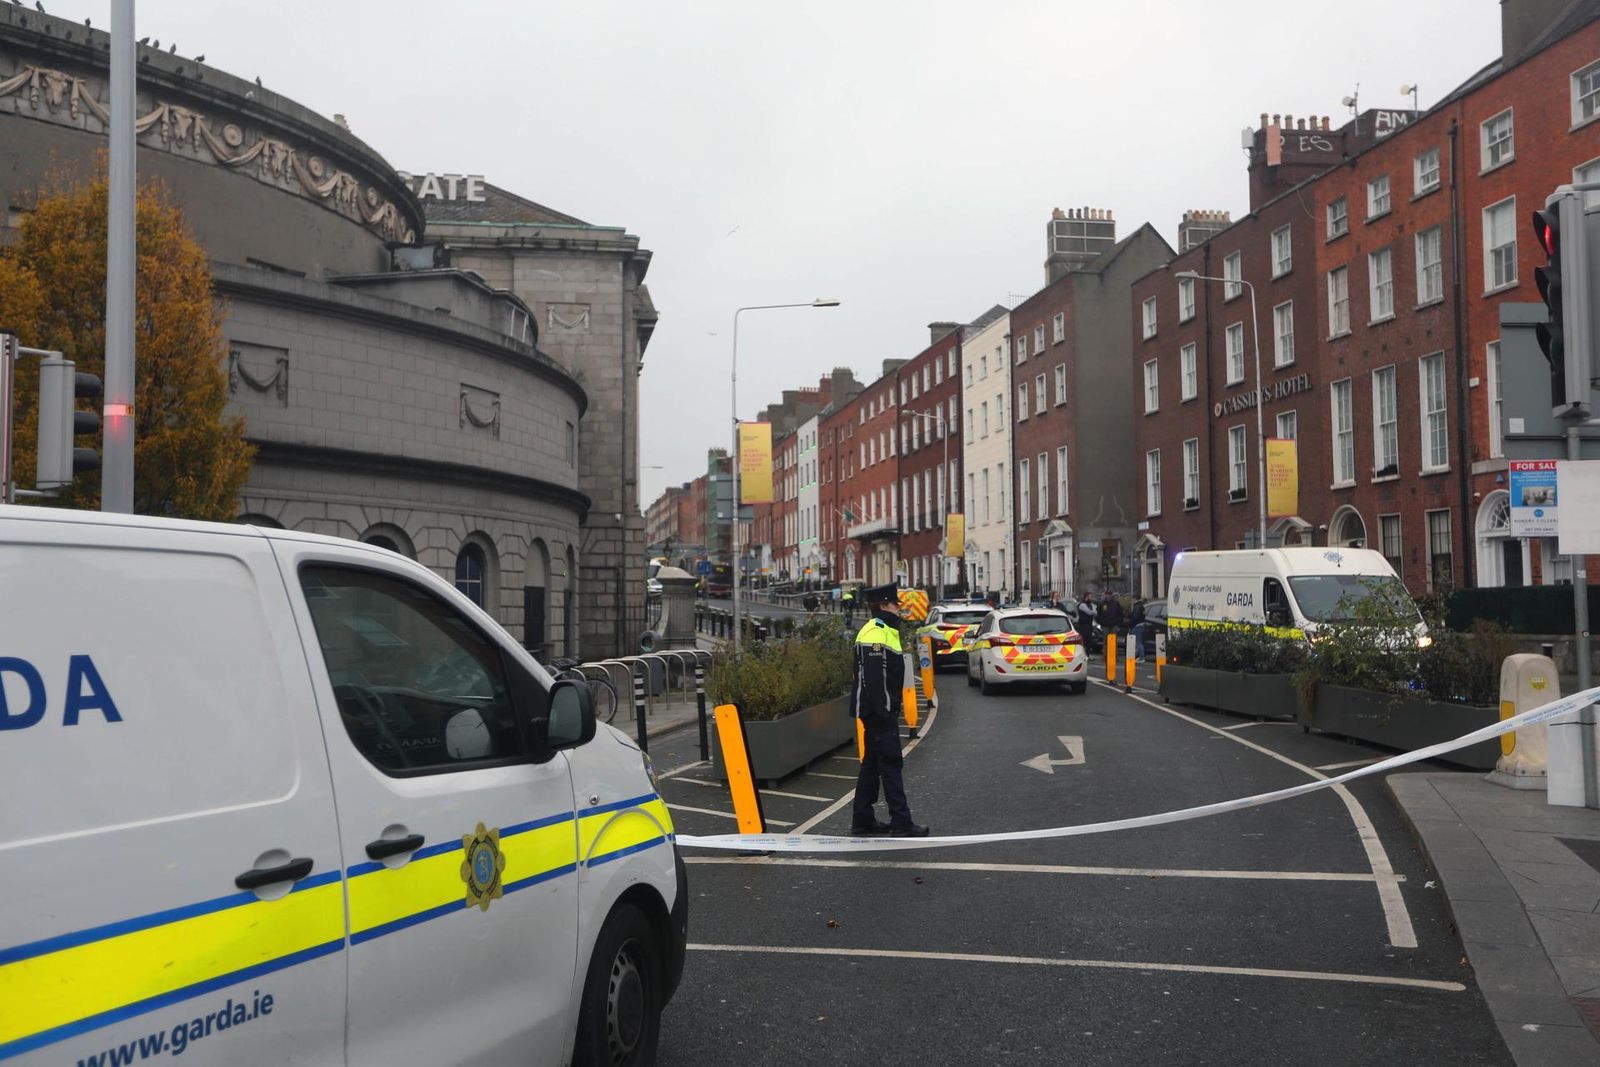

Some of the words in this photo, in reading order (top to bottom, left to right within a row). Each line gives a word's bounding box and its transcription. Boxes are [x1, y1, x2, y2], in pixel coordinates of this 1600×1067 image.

[1275, 372, 1312, 399] HOTEL
[1516, 462, 1535, 470] FOR
[1538, 462, 1558, 470] SAL
[1226, 592, 1254, 607] GARDA
[77, 989, 274, 1067] www.garda.ie
